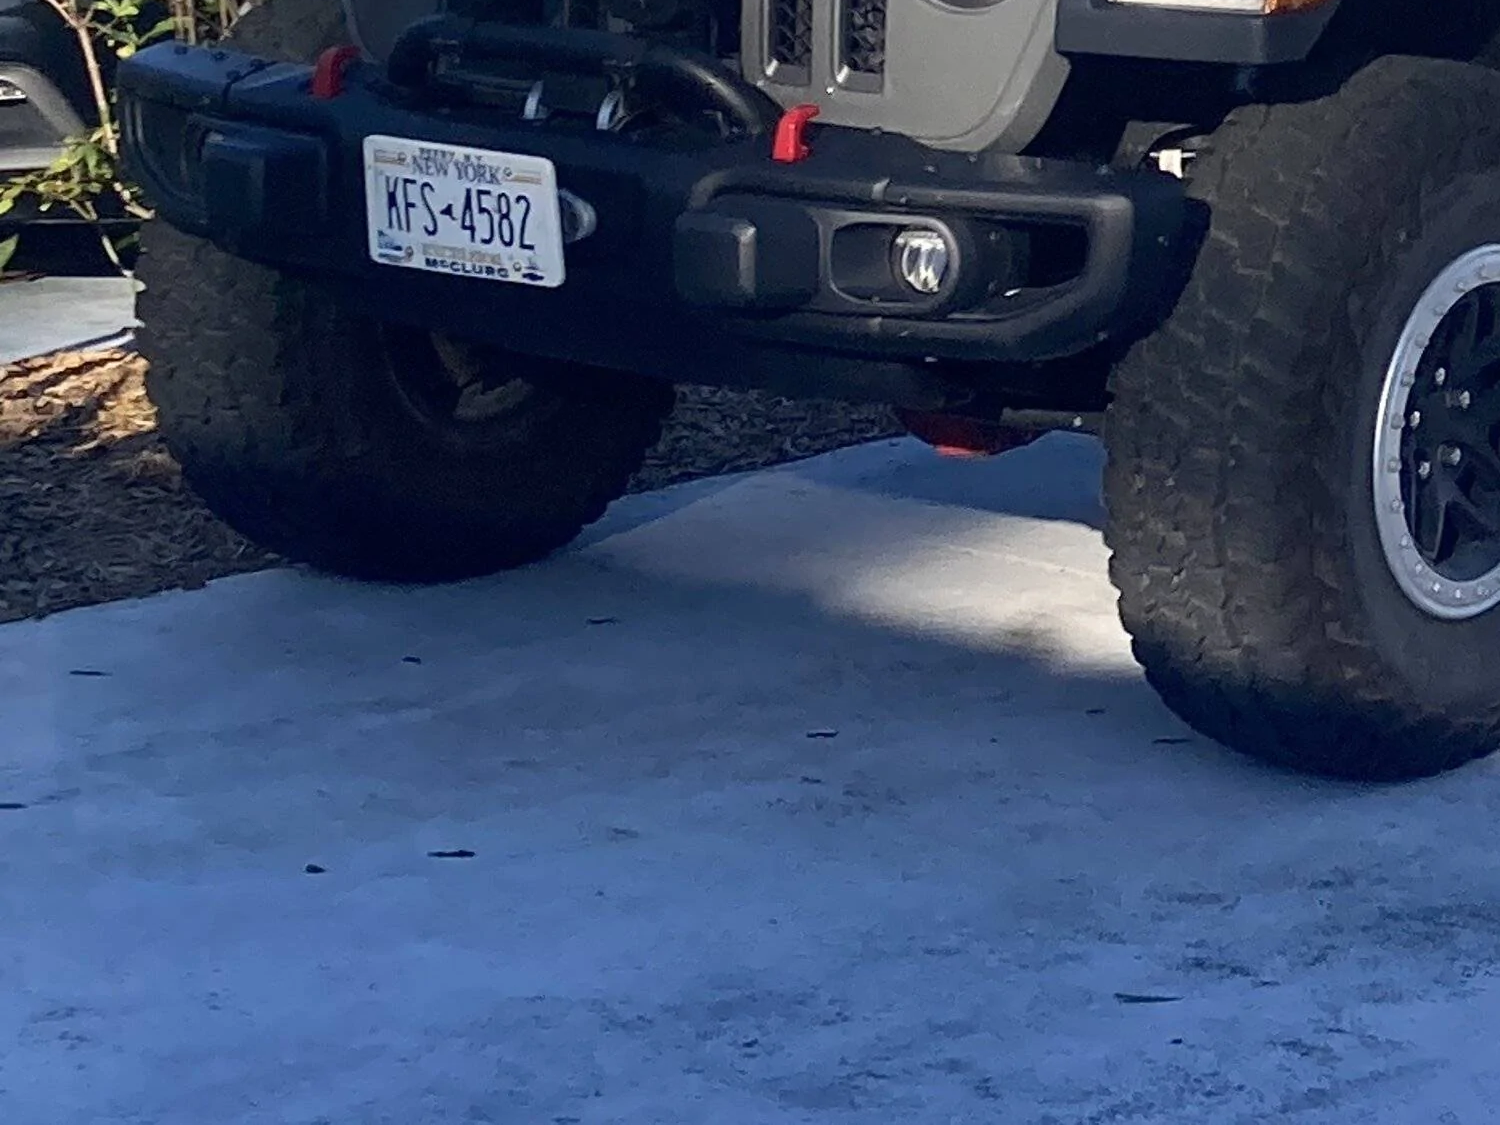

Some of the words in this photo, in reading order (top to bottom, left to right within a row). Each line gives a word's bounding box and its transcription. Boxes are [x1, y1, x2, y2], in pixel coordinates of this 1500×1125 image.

[411, 155, 451, 176] NEW
[453, 160, 502, 186] YORK
[386, 176, 439, 236] KFS
[460, 188, 536, 251] 4582
